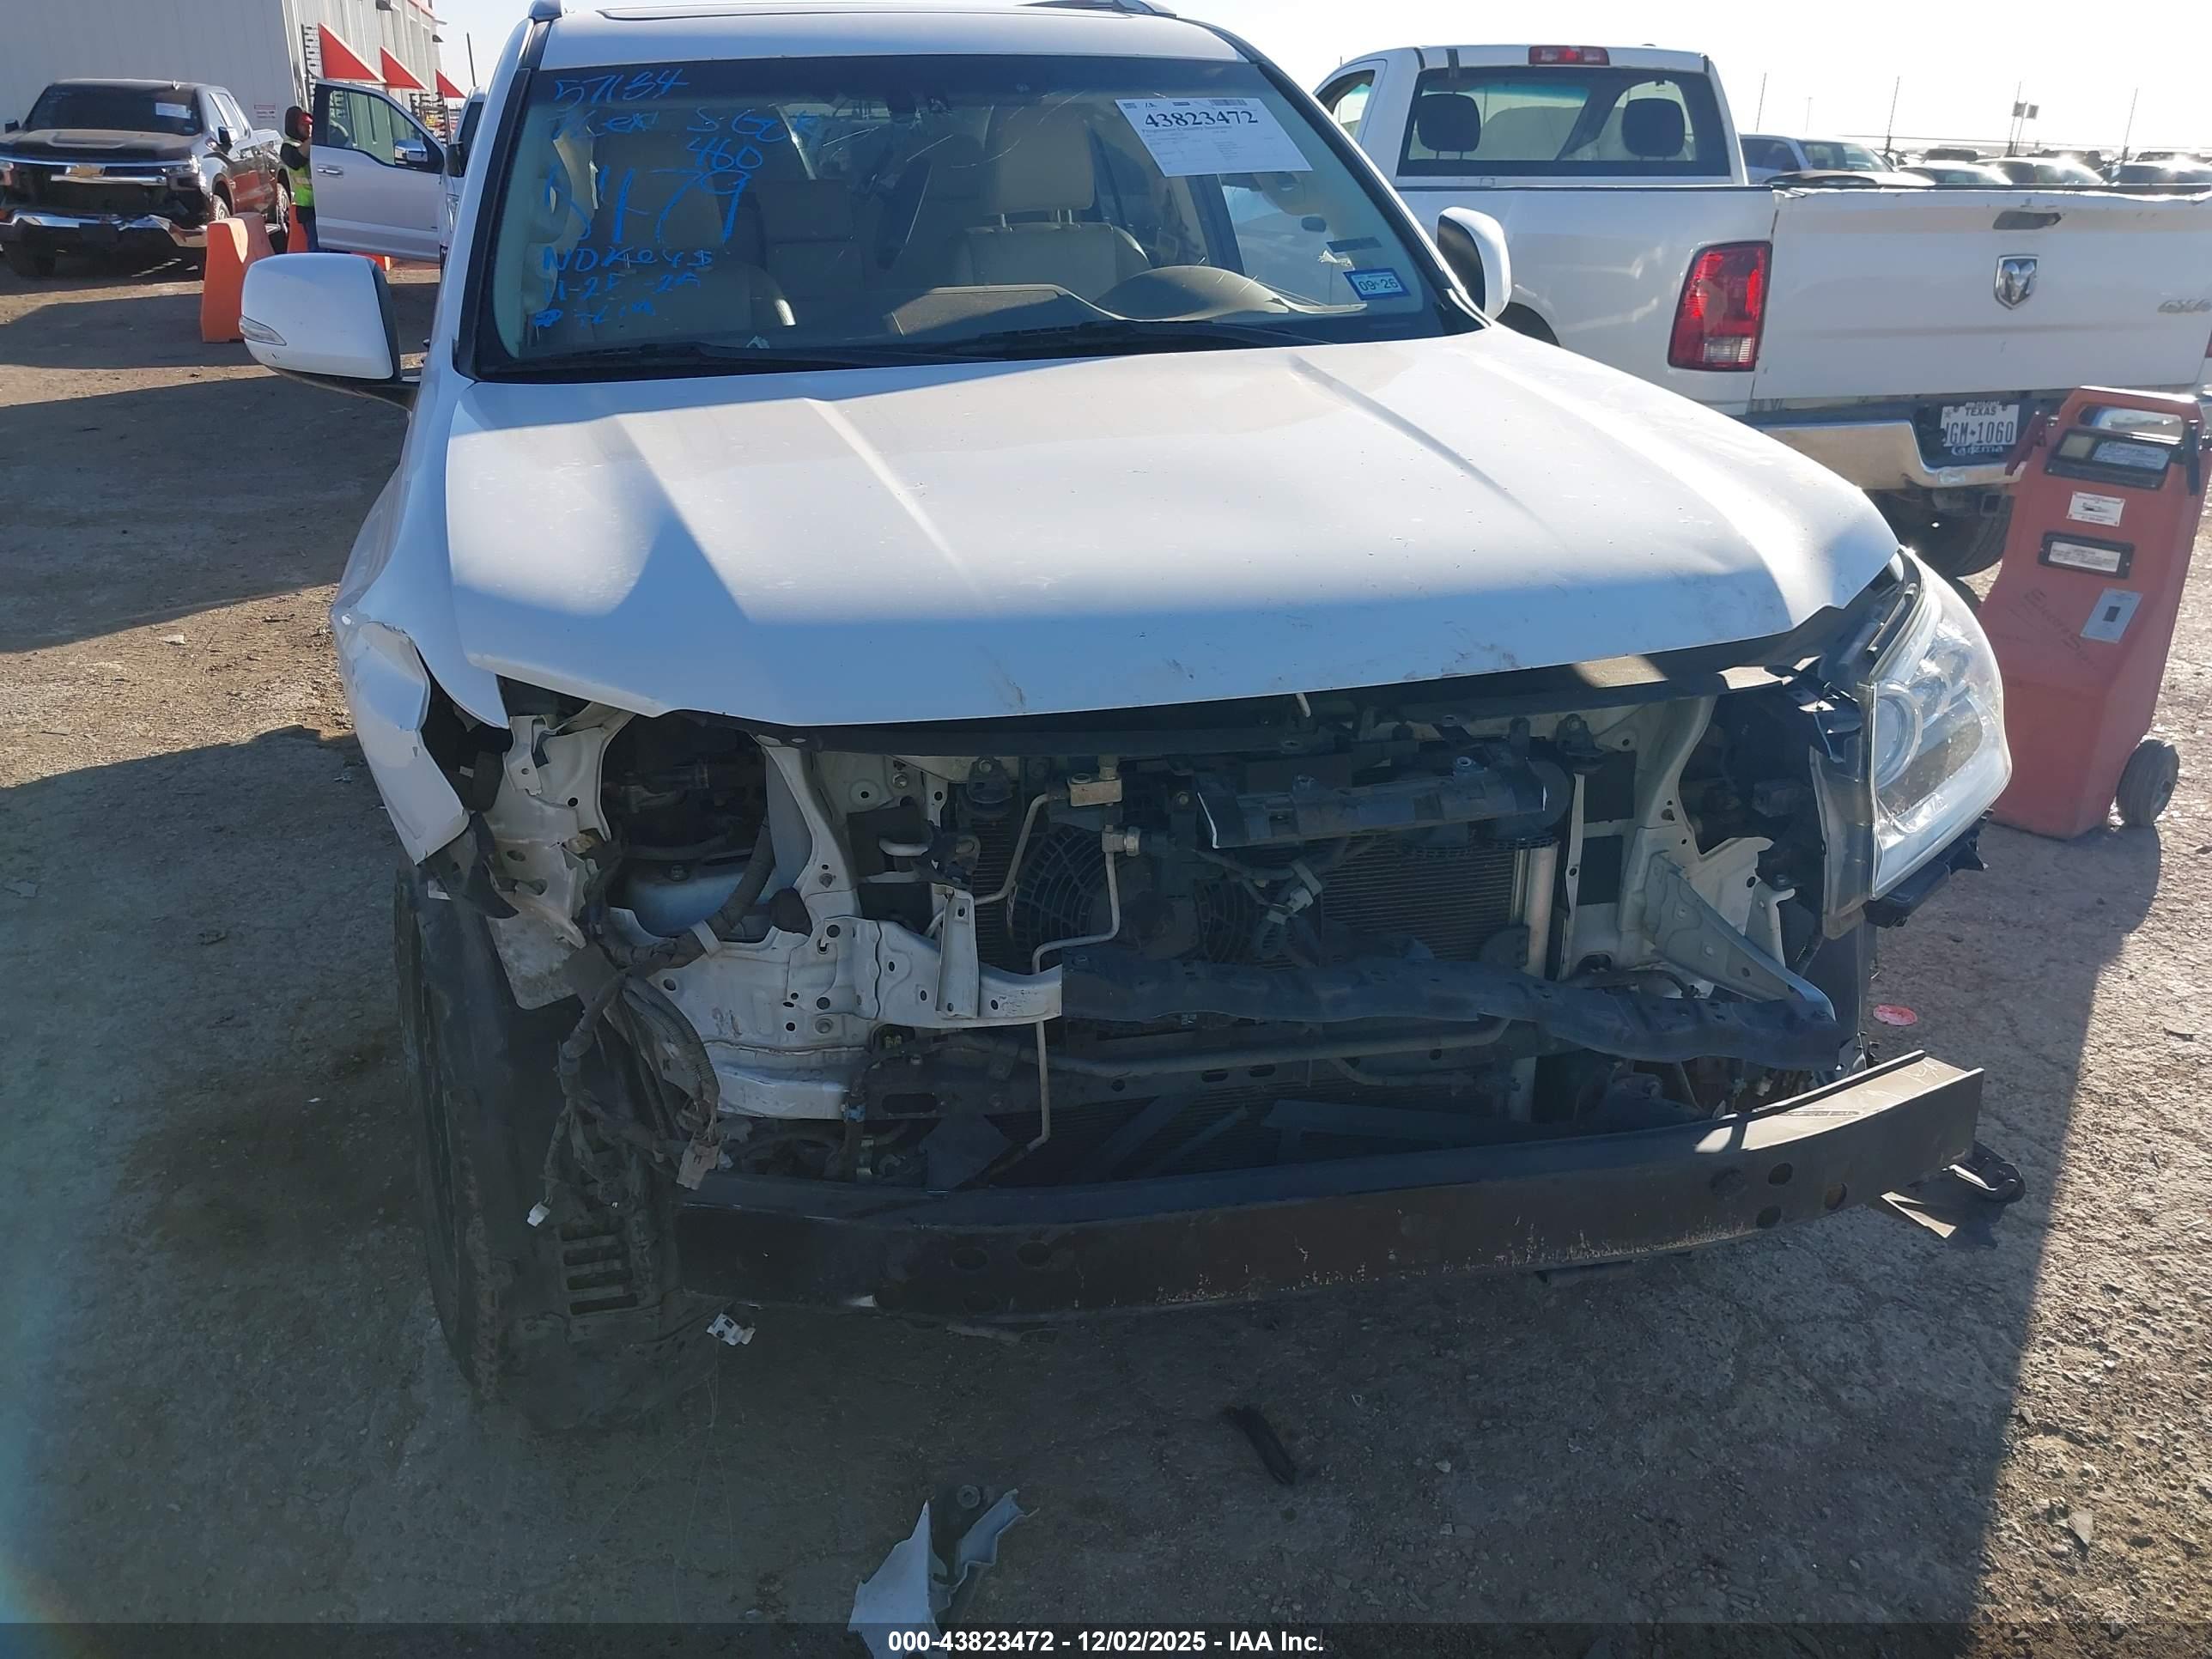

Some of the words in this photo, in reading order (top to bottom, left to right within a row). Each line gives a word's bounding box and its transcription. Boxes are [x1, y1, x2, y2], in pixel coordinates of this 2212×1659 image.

[1145, 110, 1259, 128] 43823472
[1358, 280, 1376, 291] 09
[1380, 277, 1399, 289] 26
[1965, 406, 1997, 416] TEXAS
[1976, 421, 2014, 444] 1060
